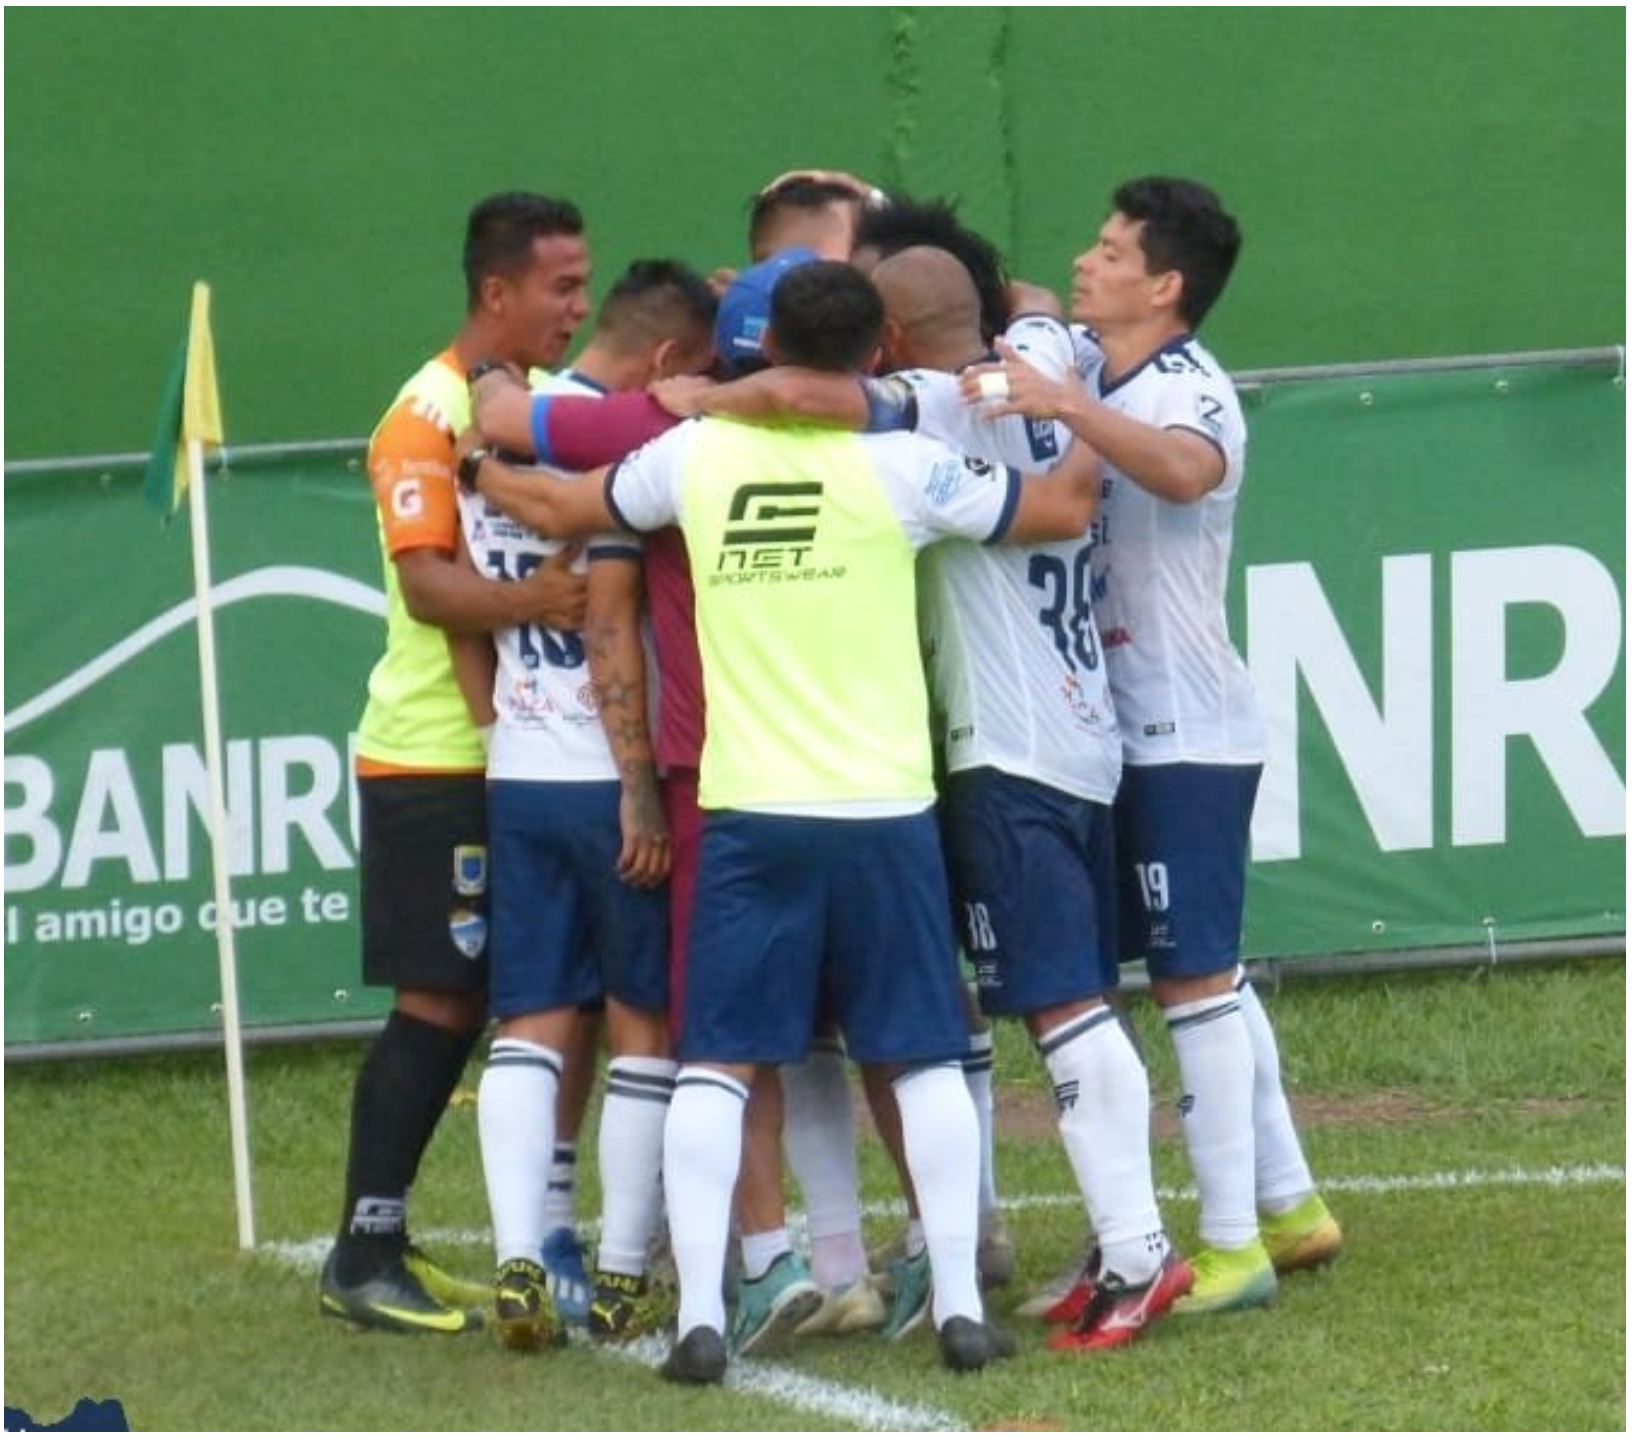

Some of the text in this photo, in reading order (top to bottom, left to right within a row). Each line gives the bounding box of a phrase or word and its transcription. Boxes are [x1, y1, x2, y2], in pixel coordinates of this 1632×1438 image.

[391, 477, 424, 519] G
[4, 732, 361, 892] BANR
[1134, 862, 1169, 911] 19
[35, 898, 182, 945] amigo
[302, 887, 350, 923] te
